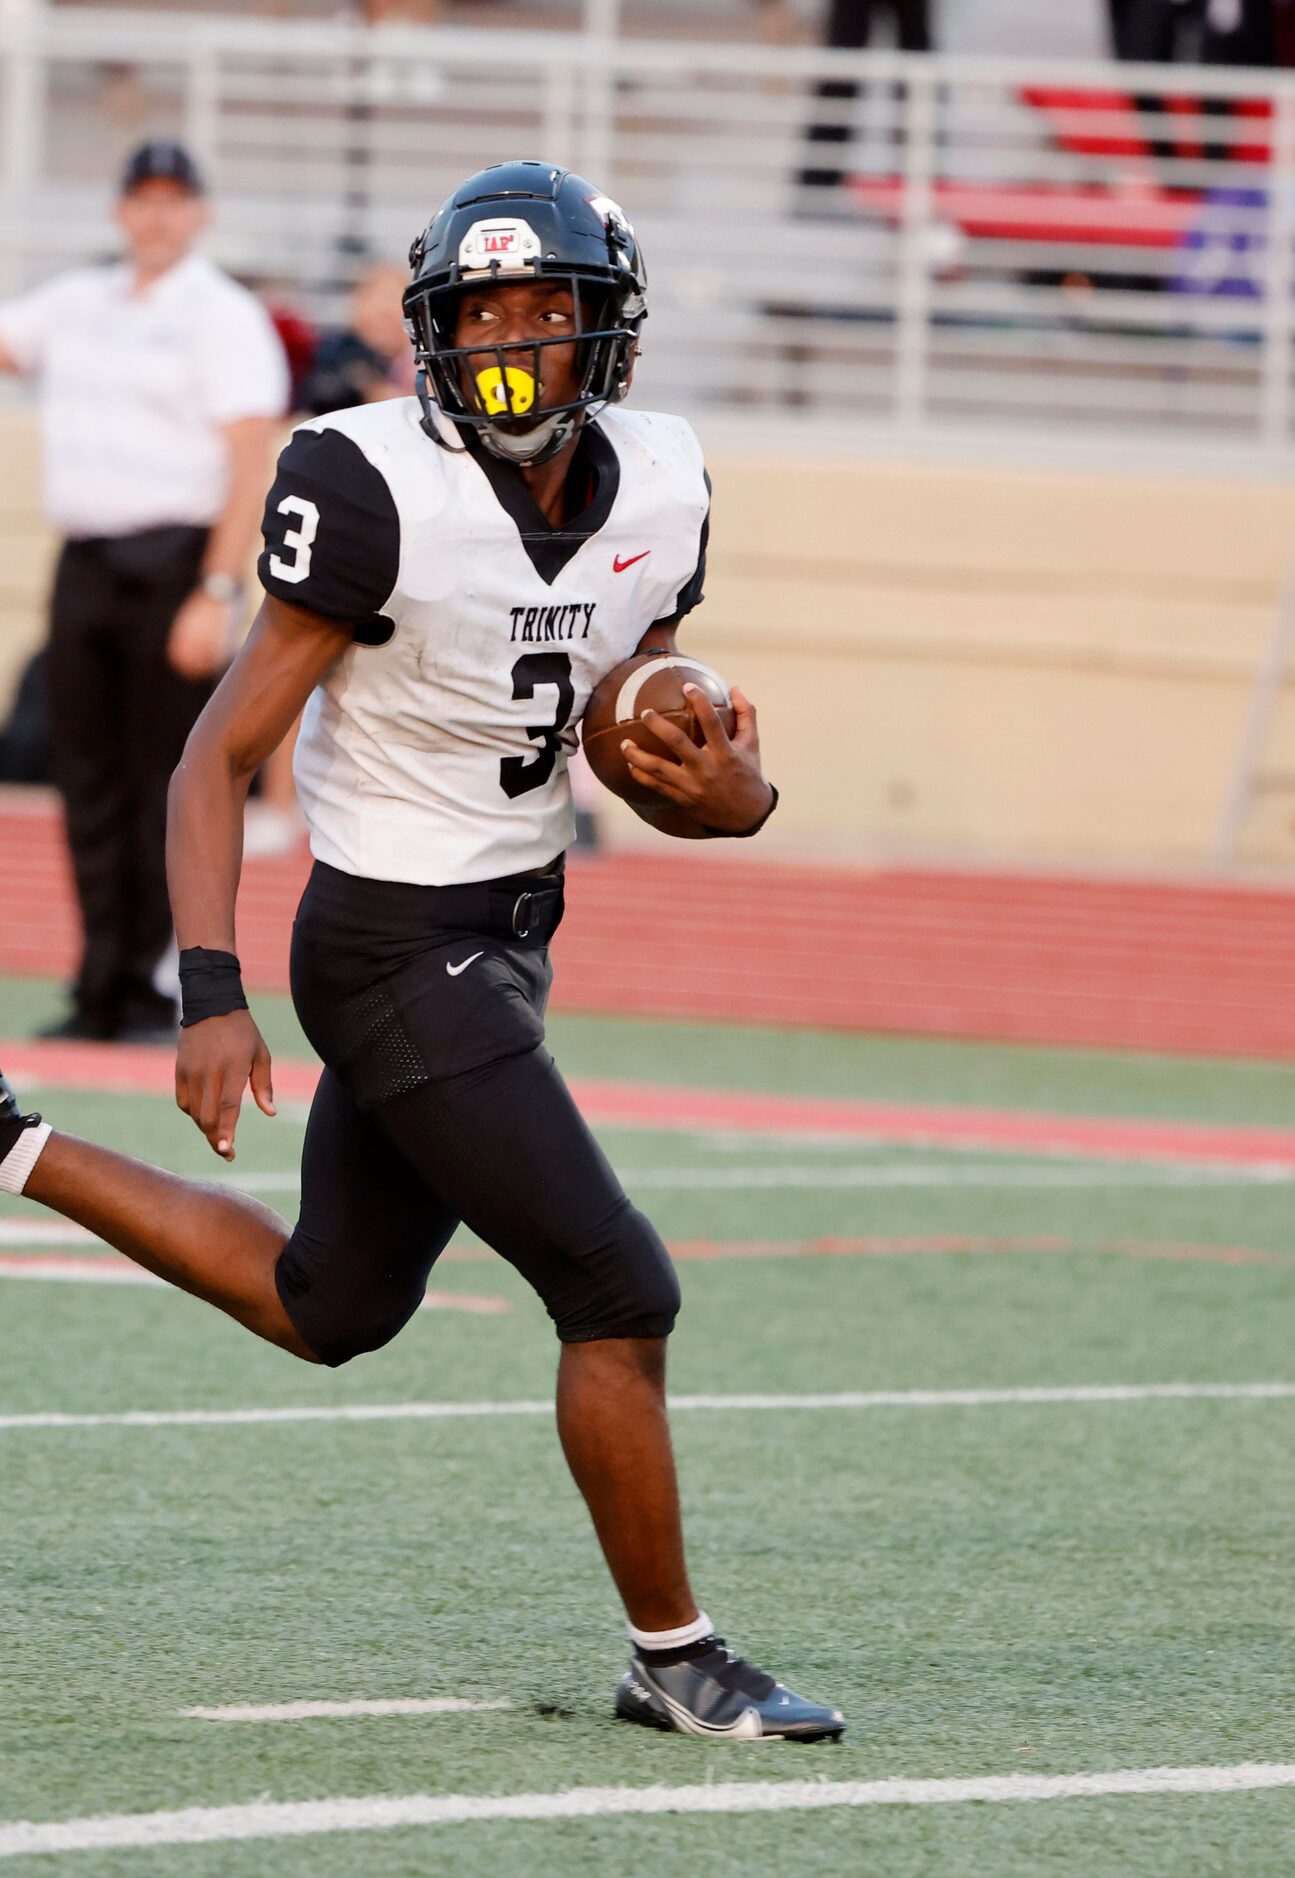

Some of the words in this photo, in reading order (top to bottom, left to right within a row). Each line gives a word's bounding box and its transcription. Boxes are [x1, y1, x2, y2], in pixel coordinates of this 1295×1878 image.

[268, 494, 321, 585] 3
[509, 602, 596, 642] TRINITY
[499, 651, 576, 800] 3
